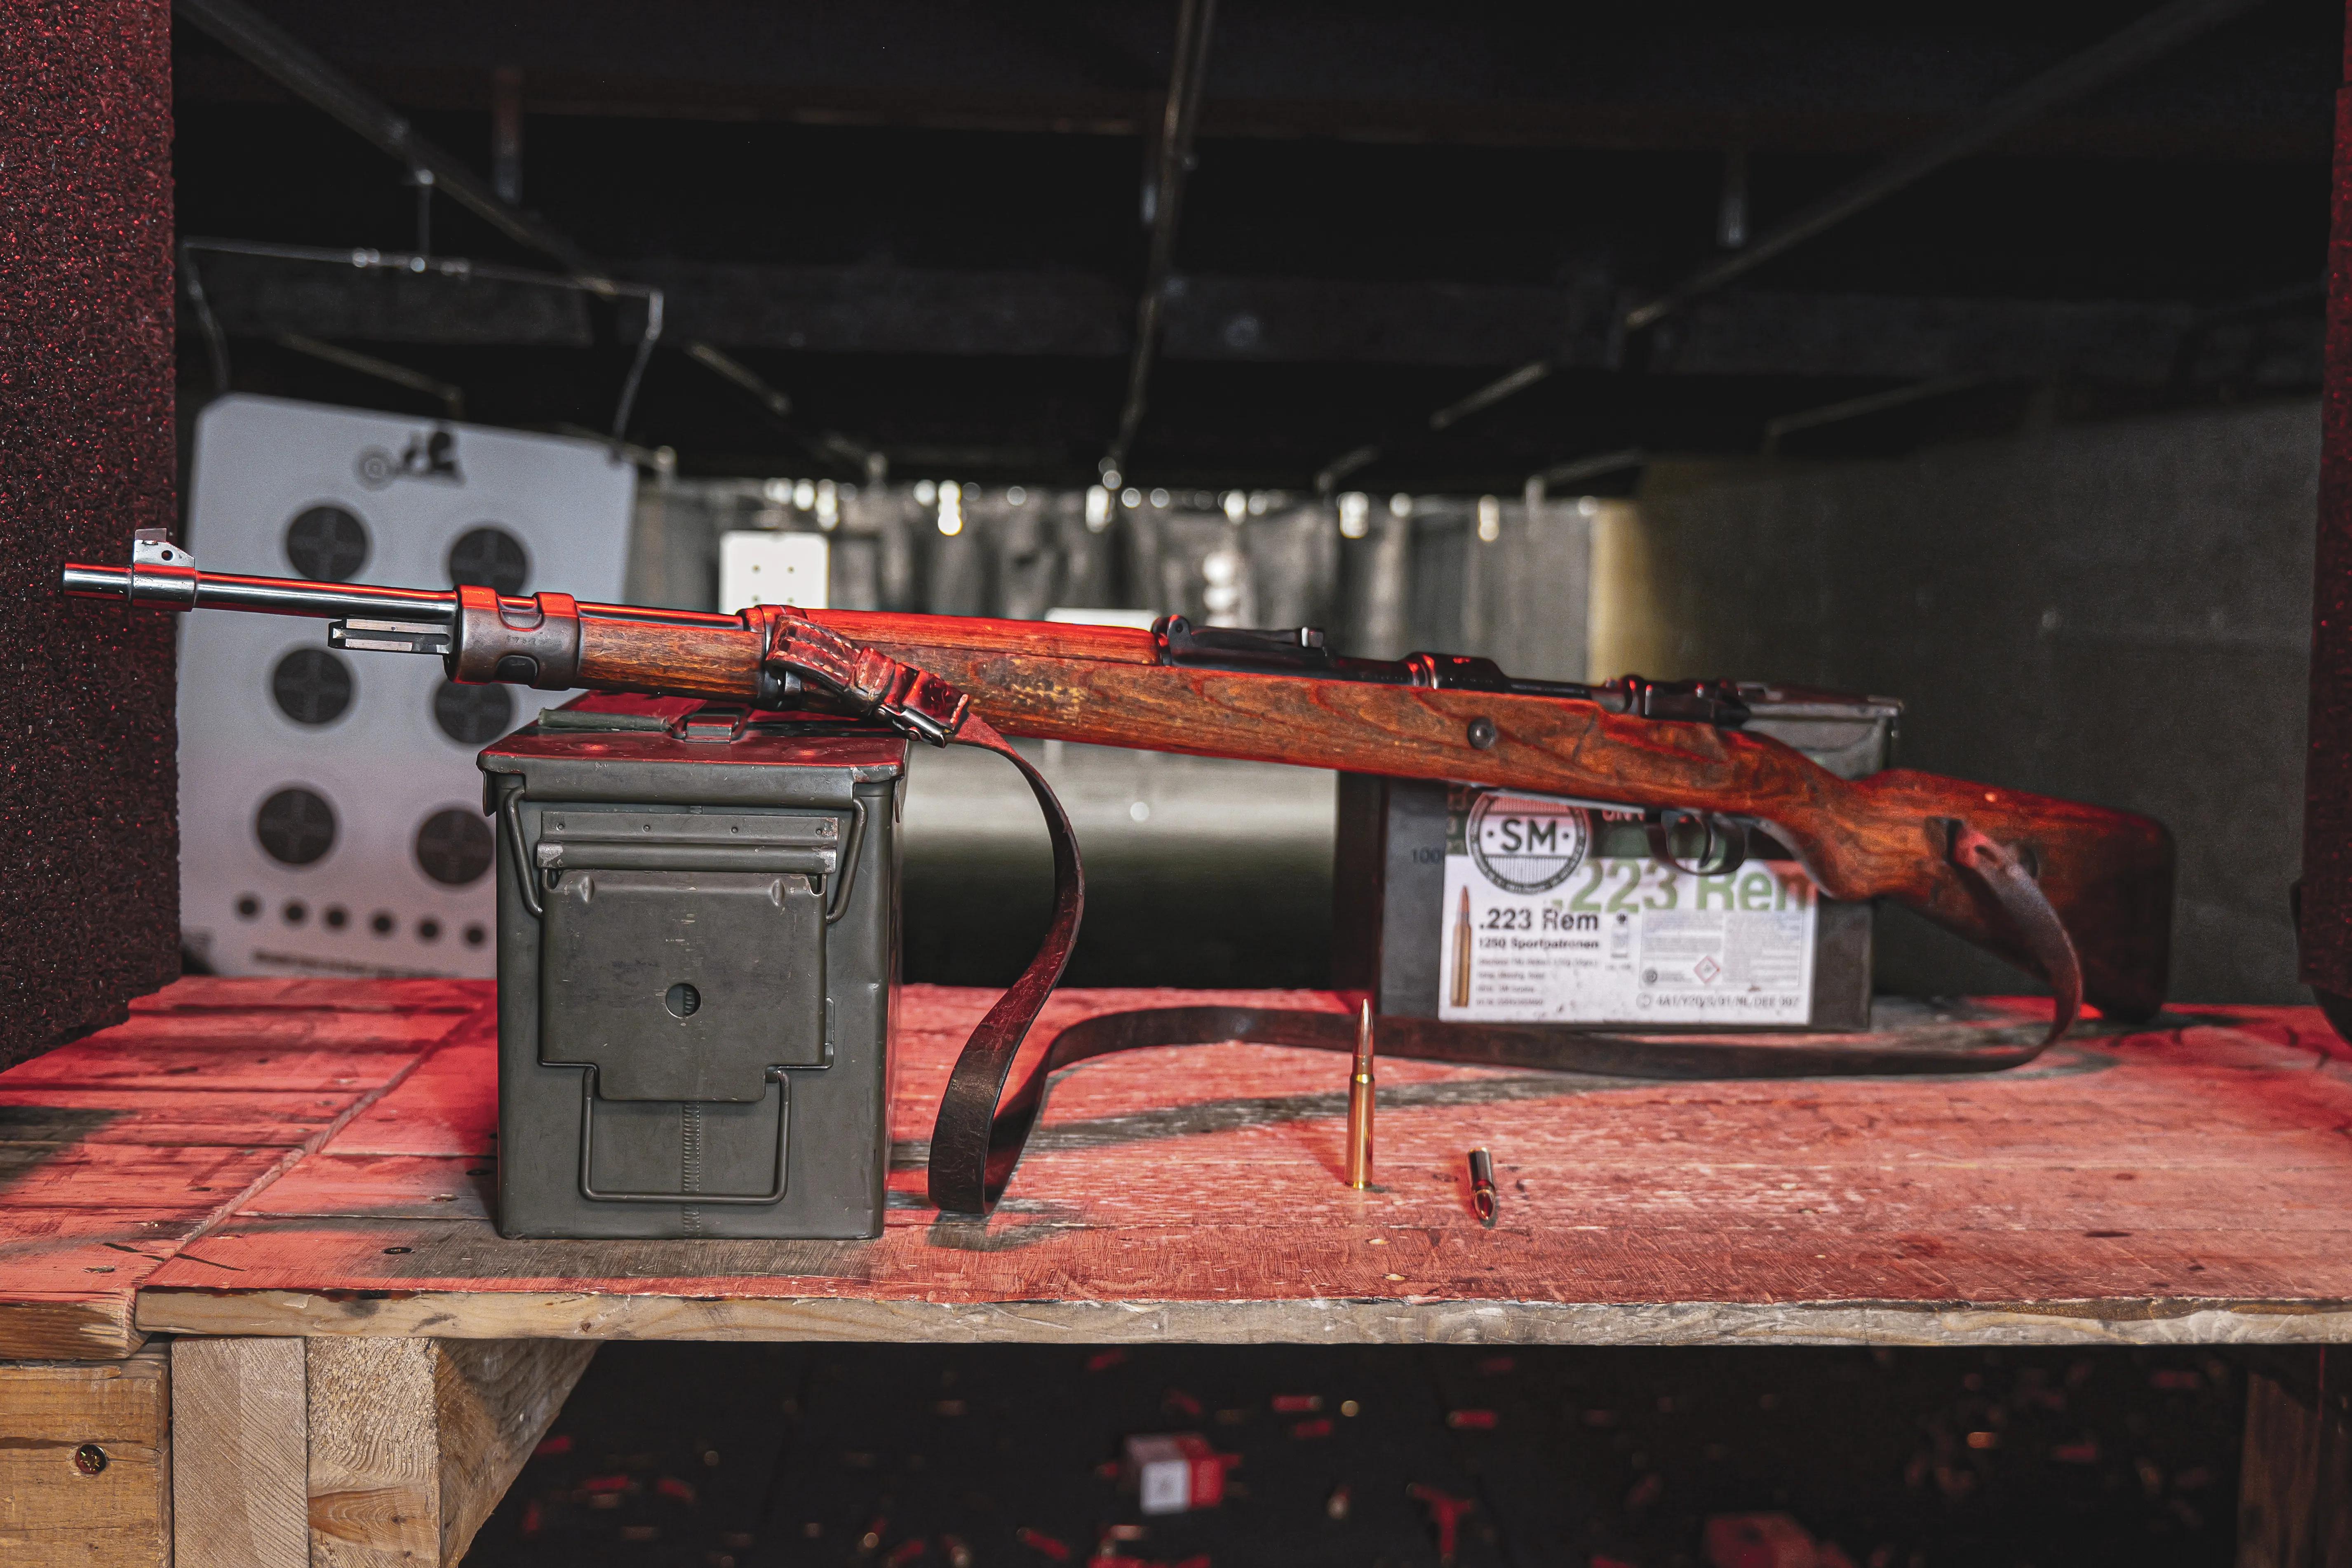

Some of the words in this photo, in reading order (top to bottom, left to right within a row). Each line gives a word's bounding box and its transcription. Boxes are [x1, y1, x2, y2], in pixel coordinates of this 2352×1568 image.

[1500, 818, 1556, 852] SM
[1552, 858, 1678, 913] .223
[1479, 908, 1531, 930] .223
[1542, 908, 1599, 931] Rem
[1511, 938, 1599, 950] Sportpatronen
